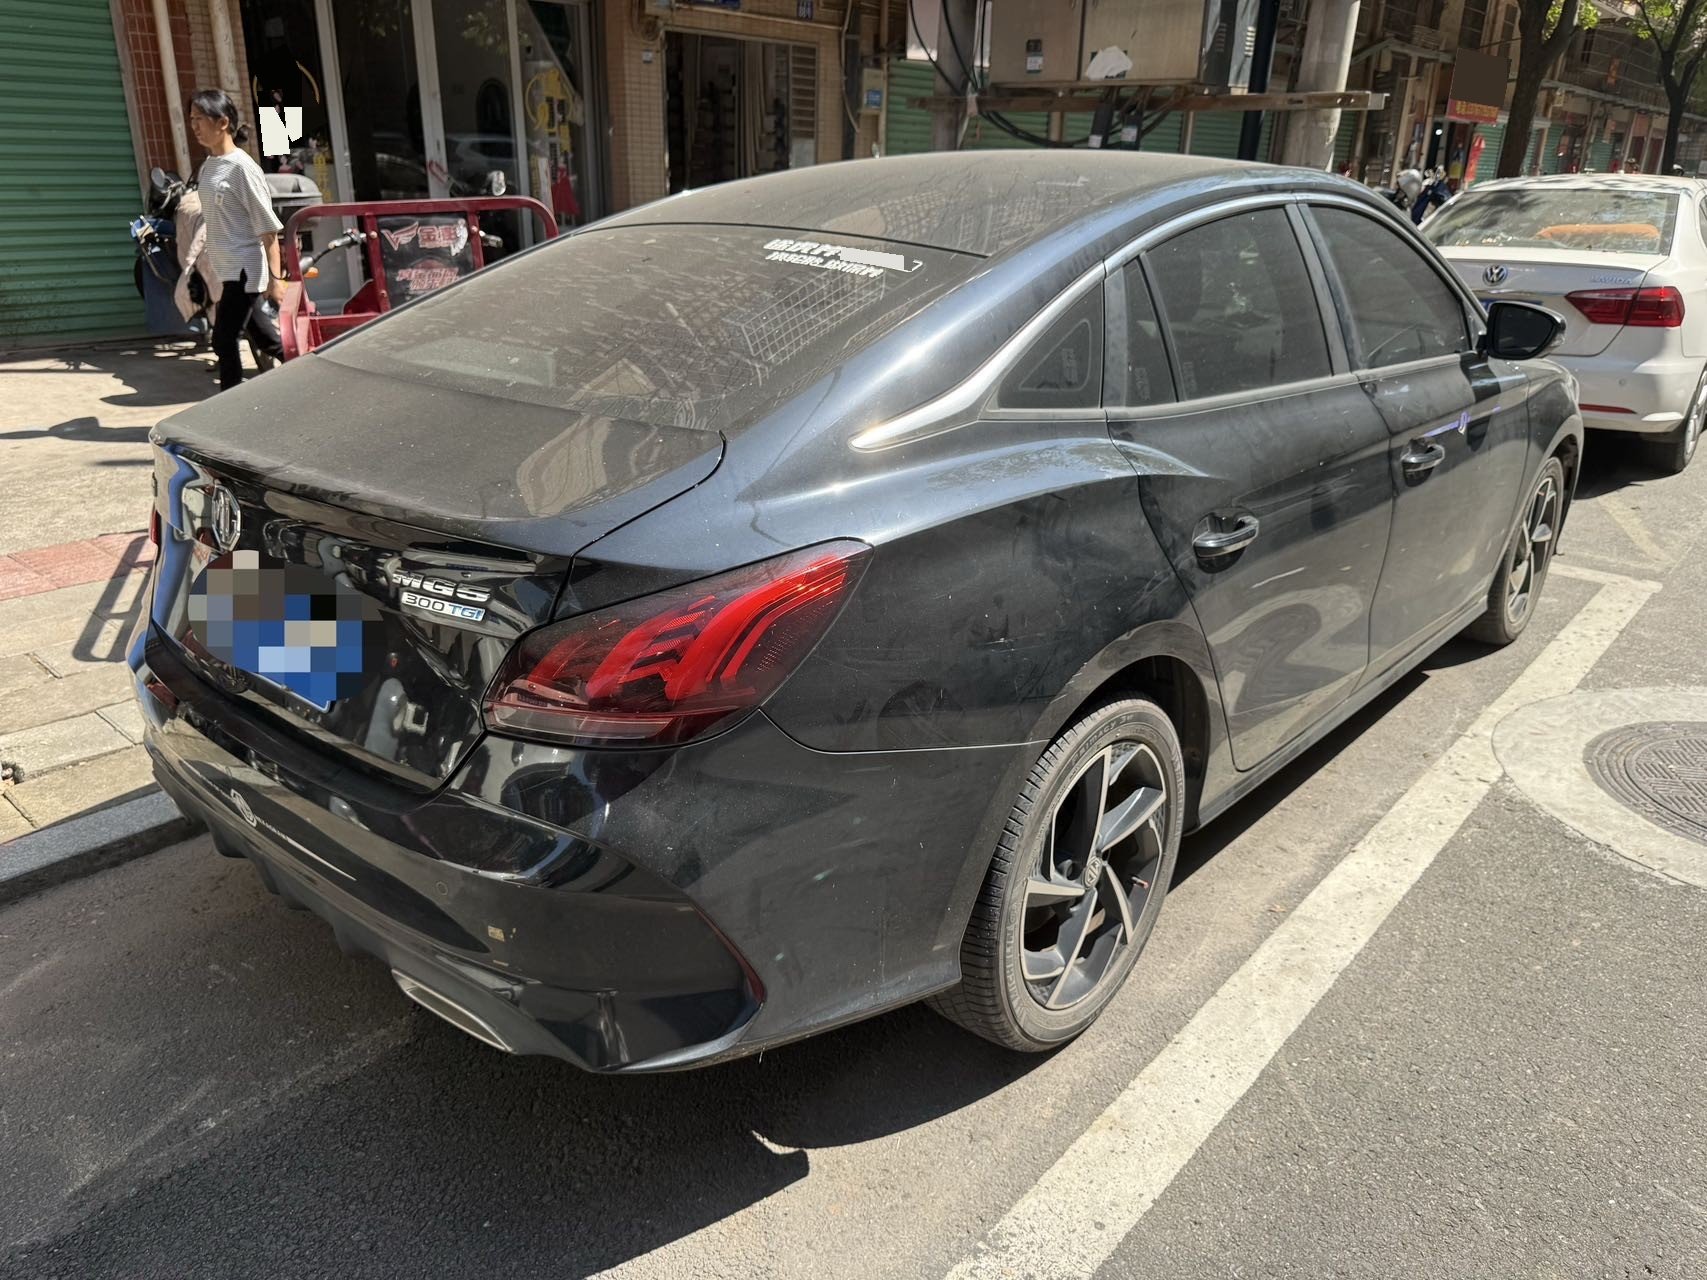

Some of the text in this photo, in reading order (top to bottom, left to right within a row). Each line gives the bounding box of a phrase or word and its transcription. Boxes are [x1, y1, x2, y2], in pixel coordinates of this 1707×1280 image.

[392, 570, 491, 602] MG5
[405, 593, 485, 620] 300 TGI
